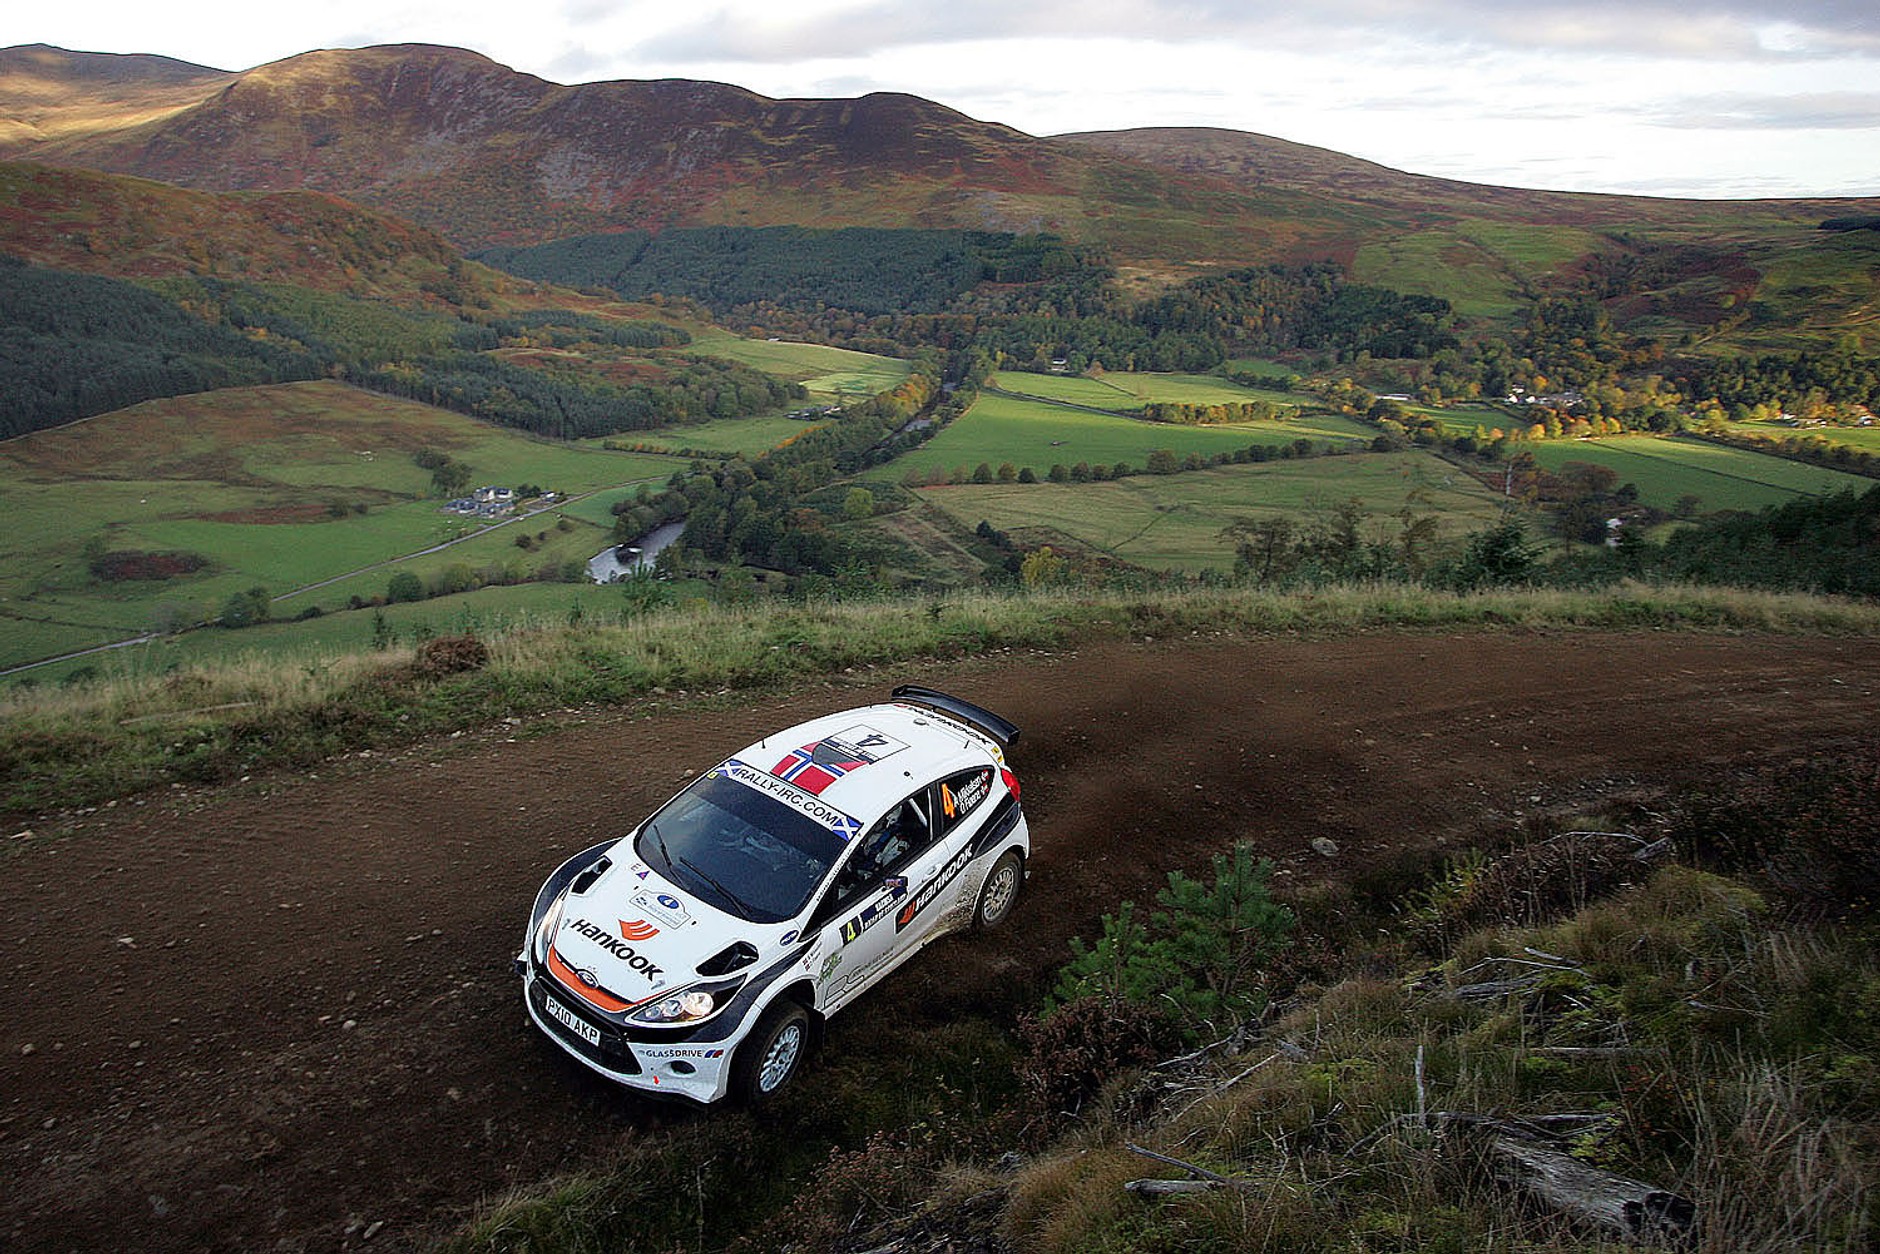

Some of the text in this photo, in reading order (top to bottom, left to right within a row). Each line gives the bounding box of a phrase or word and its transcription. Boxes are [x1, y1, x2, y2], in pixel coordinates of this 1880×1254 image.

[735, 768, 838, 826] RALLY-IRC.COM
[942, 783, 955, 819] 4
[847, 921, 856, 942] 4
[548, 997, 598, 1042] PX10 AKP
[646, 1050, 702, 1058] GLASSDRIVE
